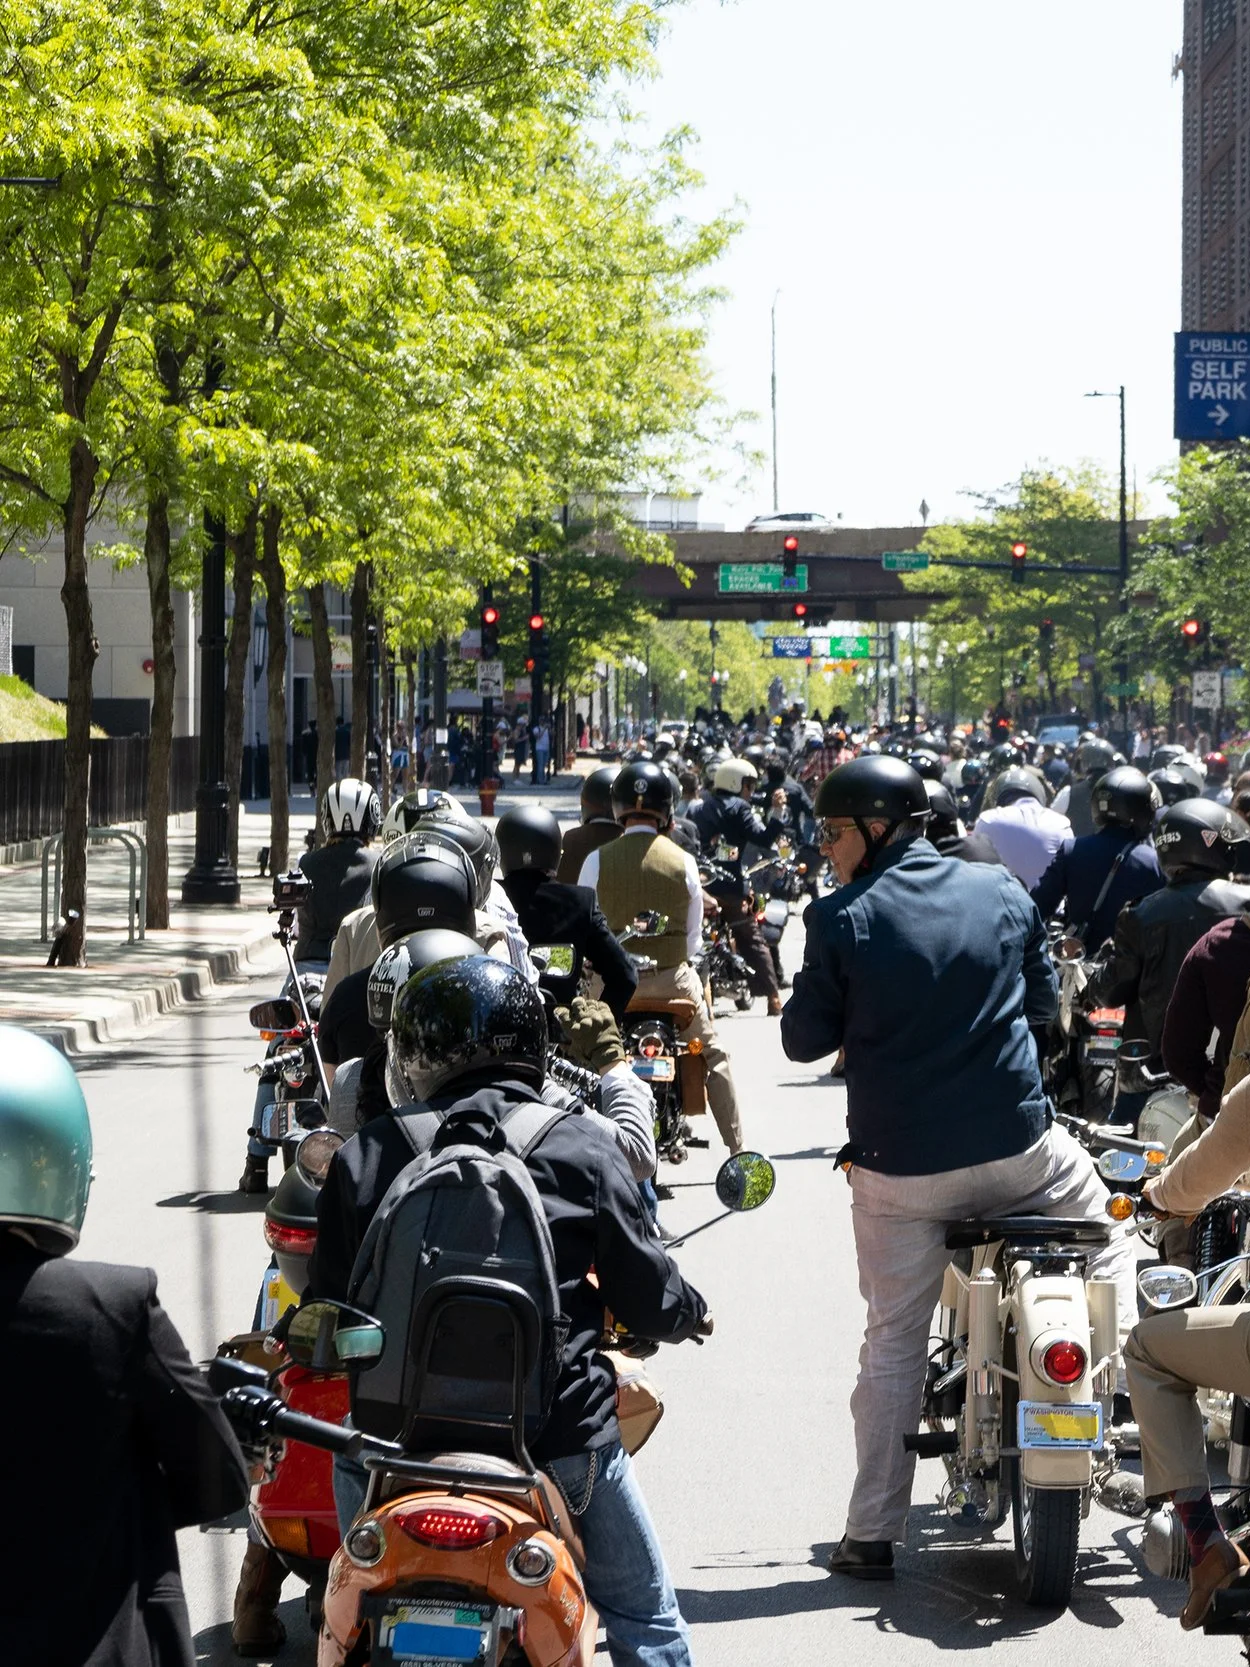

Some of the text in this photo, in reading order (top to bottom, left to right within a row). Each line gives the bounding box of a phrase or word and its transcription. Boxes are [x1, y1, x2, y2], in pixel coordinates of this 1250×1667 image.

[1189, 338, 1248, 352] PUBLIC
[1191, 360, 1247, 380] SELF
[1188, 381, 1247, 400] PARK
[481, 664, 500, 673] STOP
[1029, 1408, 1075, 1417] WASHINGTON
